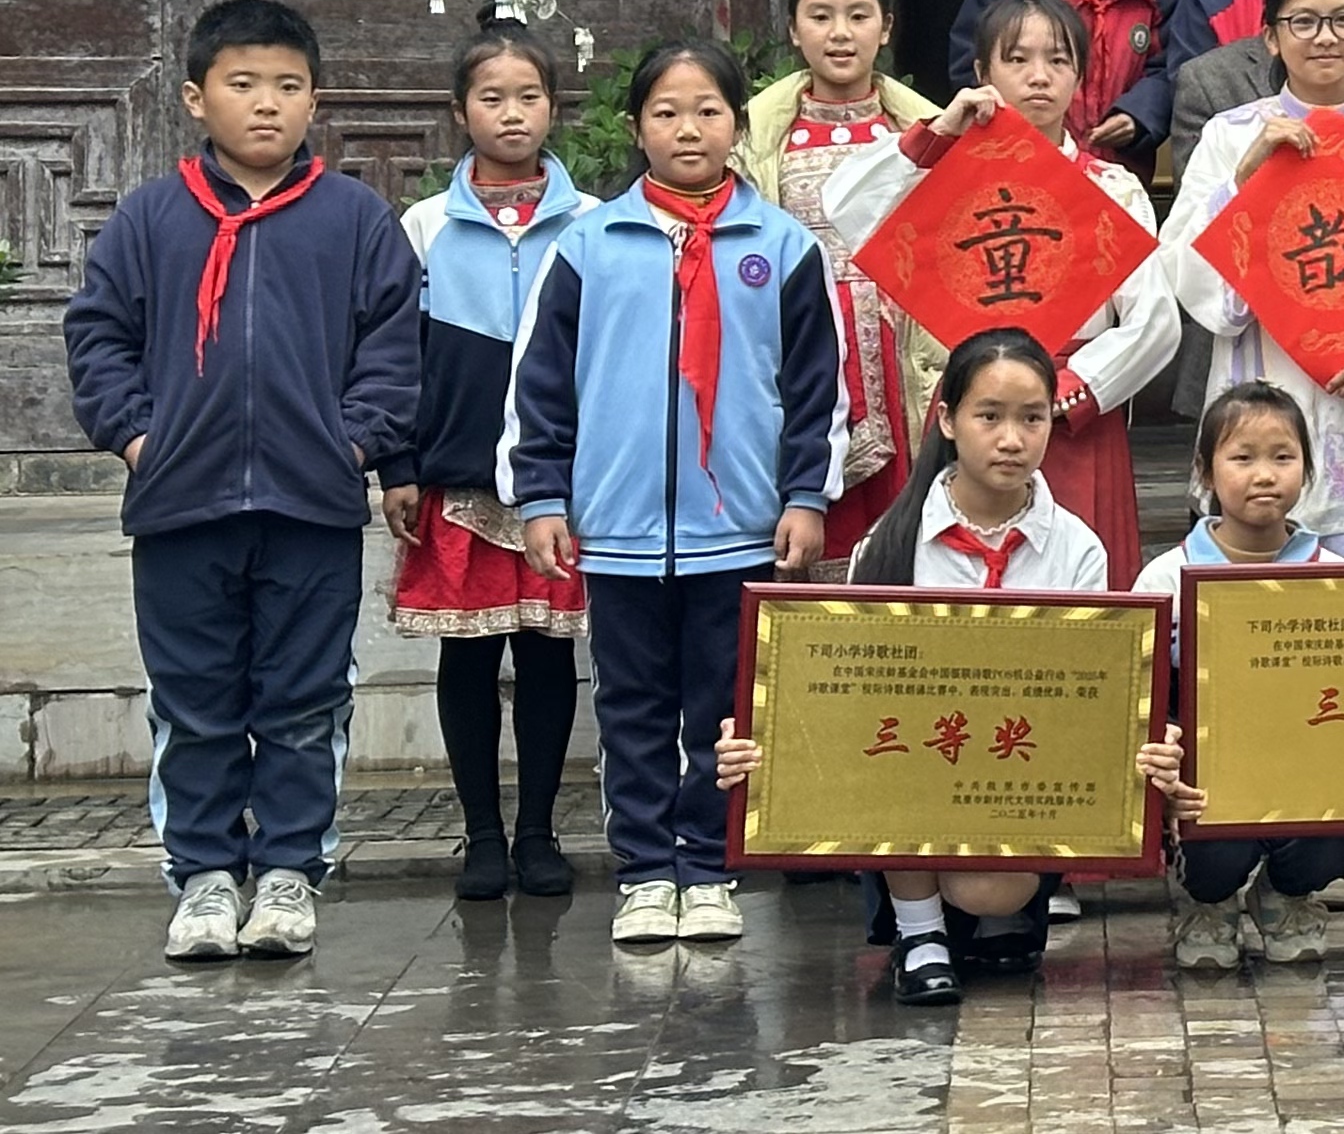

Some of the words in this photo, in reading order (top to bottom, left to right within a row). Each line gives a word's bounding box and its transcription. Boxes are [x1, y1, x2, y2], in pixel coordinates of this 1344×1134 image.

[954, 188, 1062, 308] 童
[863, 710, 1038, 764] 三等奖
